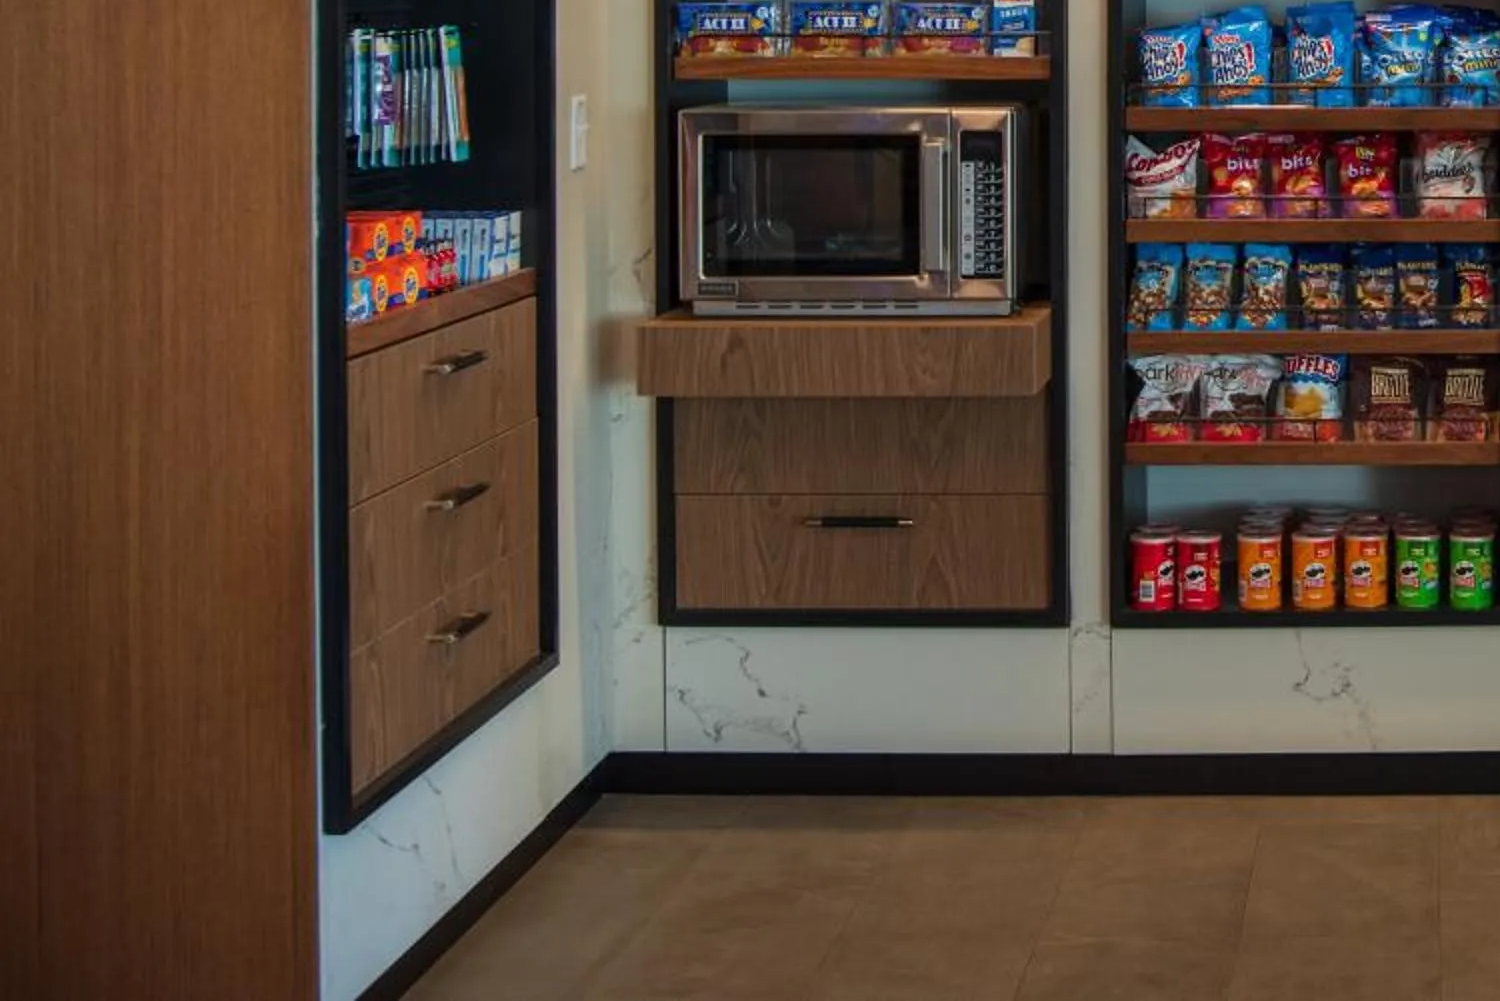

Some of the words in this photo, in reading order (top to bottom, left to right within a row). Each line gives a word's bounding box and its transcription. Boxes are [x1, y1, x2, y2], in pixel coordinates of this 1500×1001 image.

[703, 18, 729, 30] ACT
[813, 17, 840, 28] ACT
[917, 18, 944, 29] ACT
[1227, 156, 1261, 171] bits
[1281, 155, 1313, 170] bits
[1348, 163, 1375, 178] bit
[1285, 356, 1339, 380] UFFLES
